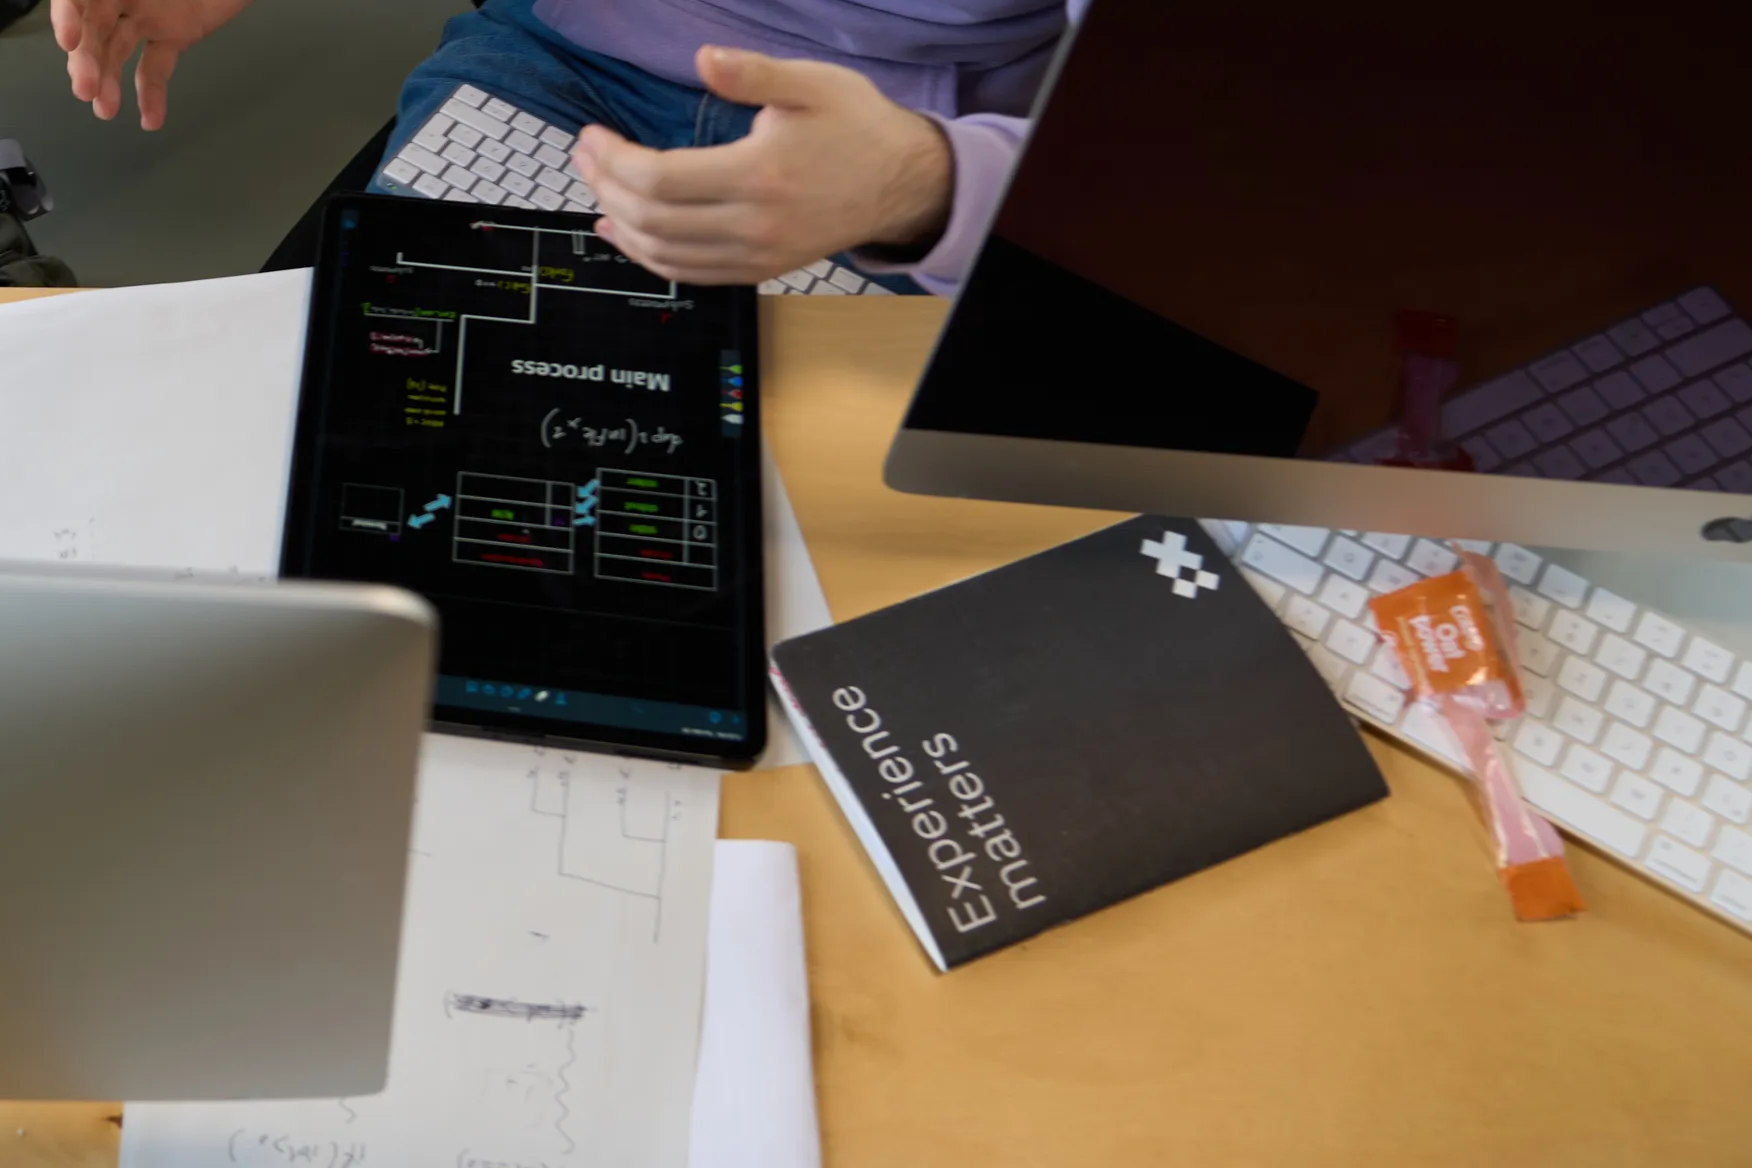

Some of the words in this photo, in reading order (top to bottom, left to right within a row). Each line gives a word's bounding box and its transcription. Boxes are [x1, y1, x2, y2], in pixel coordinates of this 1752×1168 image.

[509, 358, 606, 384] process
[609, 367, 672, 393] Main
[831, 684, 997, 934] Experience
[921, 731, 1047, 911] matters
